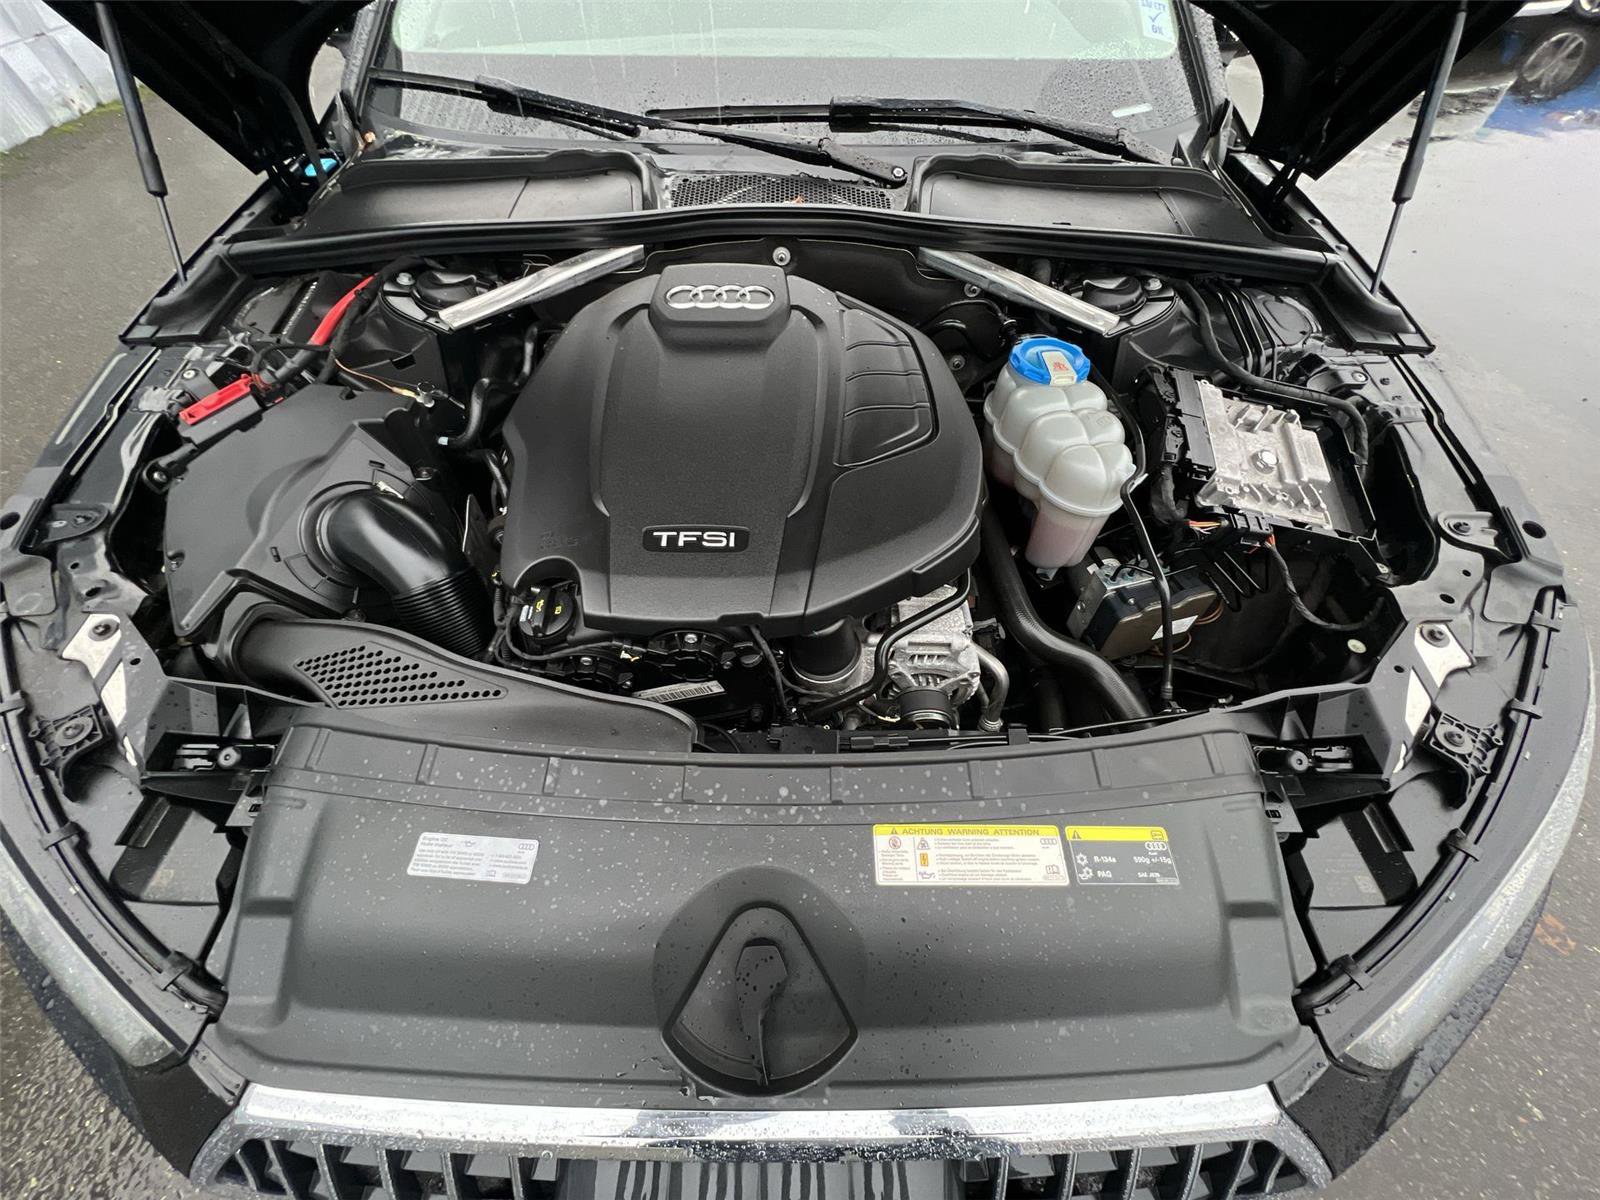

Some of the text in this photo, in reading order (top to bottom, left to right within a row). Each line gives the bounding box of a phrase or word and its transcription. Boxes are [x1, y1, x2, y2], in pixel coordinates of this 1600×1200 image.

[653, 532, 735, 547] TFSI
[902, 828, 1040, 837] ACHTUNG WARNING ATTENTION
